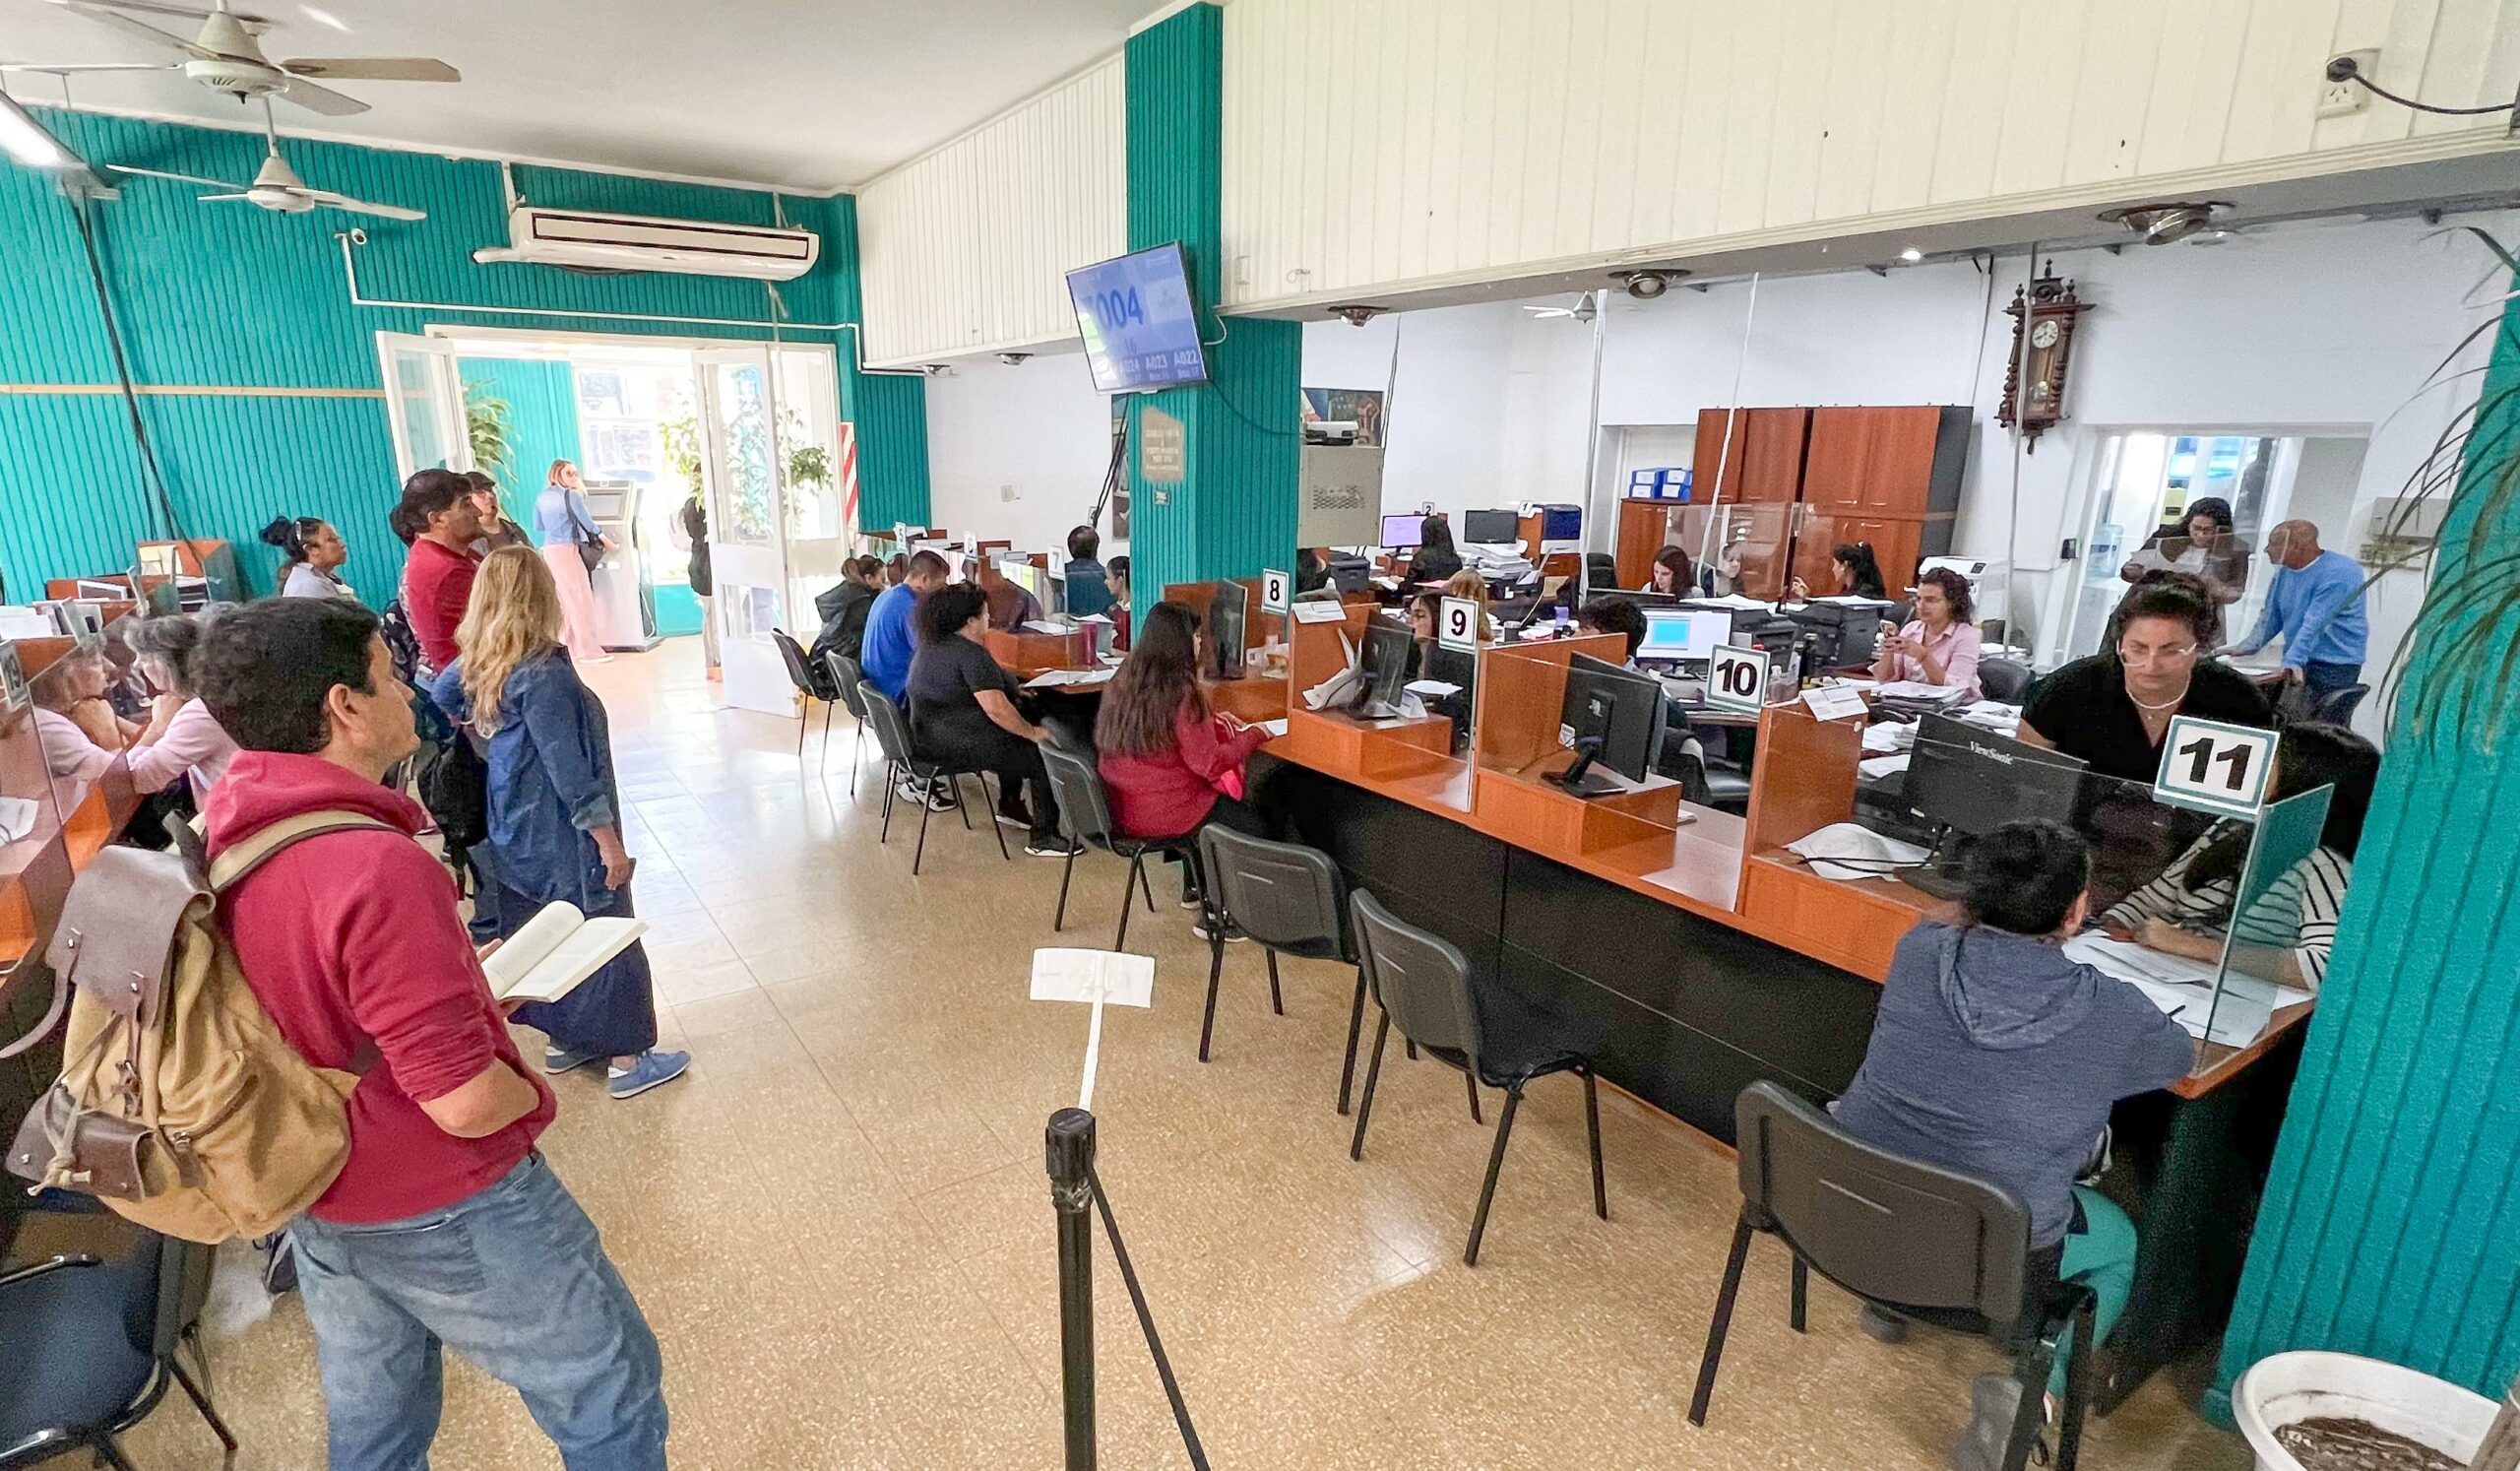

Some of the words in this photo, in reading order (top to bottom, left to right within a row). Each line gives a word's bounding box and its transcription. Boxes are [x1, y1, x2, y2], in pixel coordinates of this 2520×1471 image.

[1080, 286, 1144, 331] 004
[1173, 349, 1200, 368] A022
[1051, 550, 1060, 570] 7
[1270, 578, 1281, 603] 8
[1450, 608, 1468, 637] 9
[1717, 659, 1757, 696] 10
[2179, 736, 2253, 792] 11
